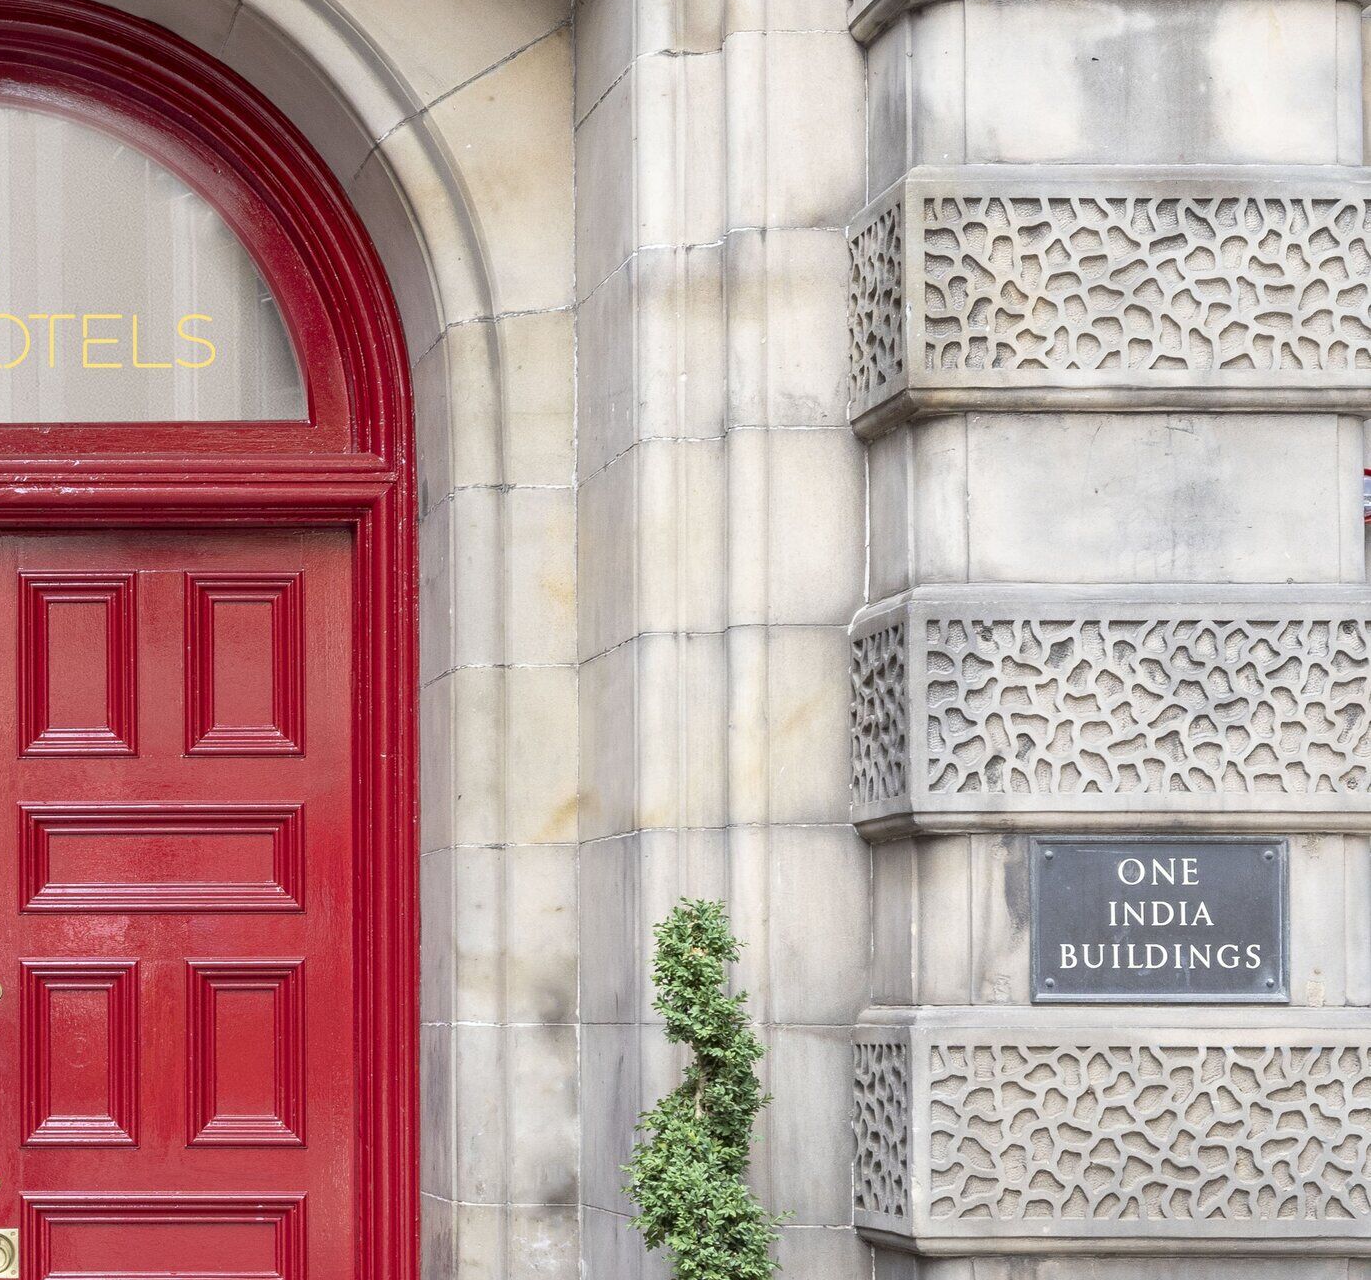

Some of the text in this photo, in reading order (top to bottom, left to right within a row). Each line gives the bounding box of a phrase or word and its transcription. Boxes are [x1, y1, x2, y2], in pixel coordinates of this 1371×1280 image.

[1117, 858, 1200, 886] ONE
[1108, 901, 1215, 927] INDIA
[1059, 943, 1262, 970] BUILDINGS
